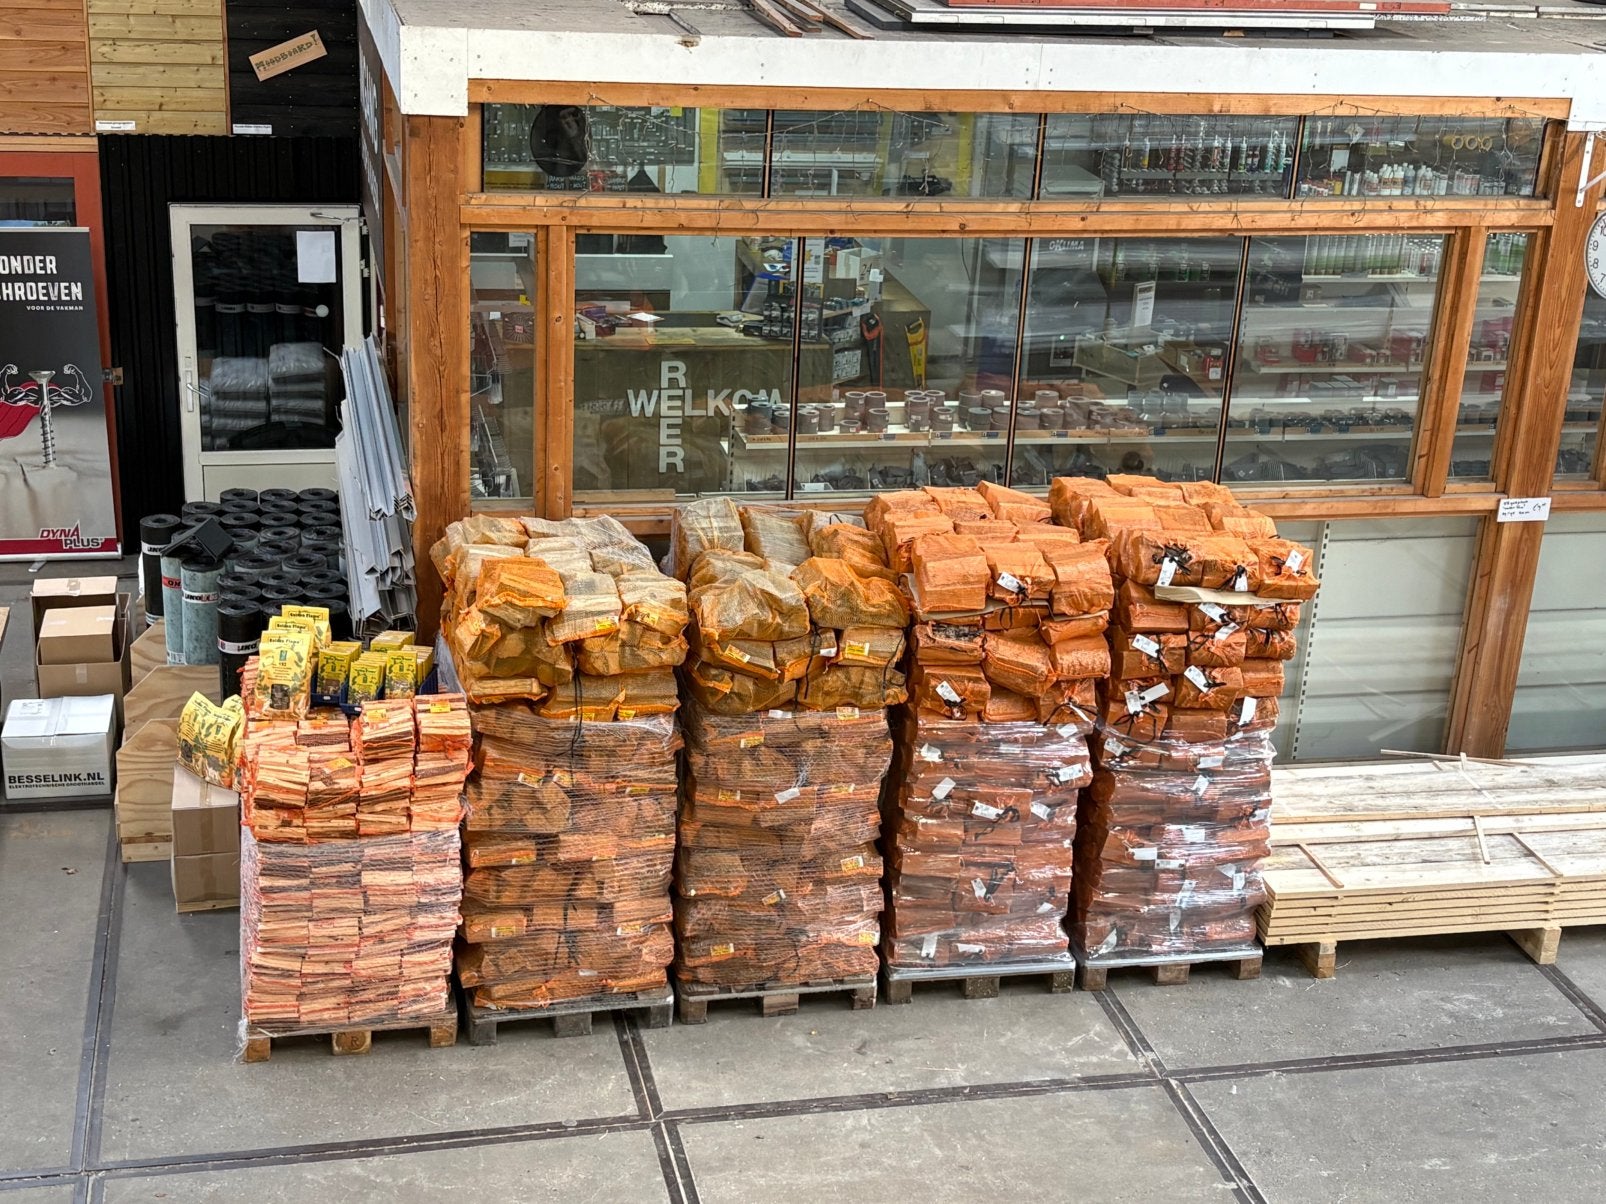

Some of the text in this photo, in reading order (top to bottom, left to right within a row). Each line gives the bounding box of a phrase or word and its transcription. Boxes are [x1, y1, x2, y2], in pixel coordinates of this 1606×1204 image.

[1592, 240, 1599, 251] 9
[0, 255, 57, 274] ONDER
[1592, 258, 1599, 269] 8
[0, 282, 83, 301] HROEVEN
[40, 523, 80, 540] DYNA
[64, 537, 101, 548] PLUS
[8, 772, 105, 784] BESSELINK.NL
